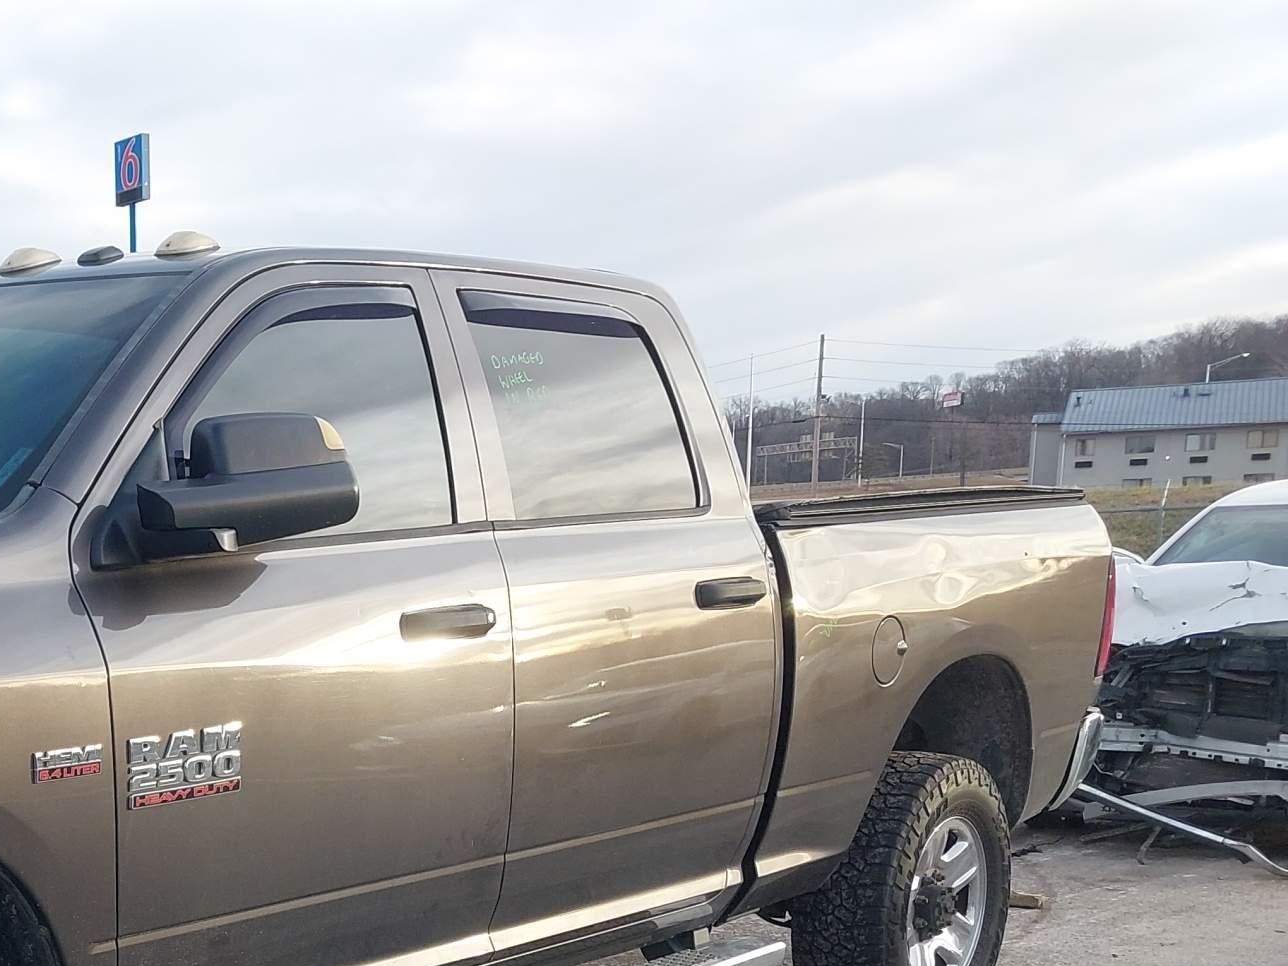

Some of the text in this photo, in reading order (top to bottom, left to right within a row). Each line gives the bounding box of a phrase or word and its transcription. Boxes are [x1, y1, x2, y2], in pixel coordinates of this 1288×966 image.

[120, 137, 140, 191] 6
[498, 370, 534, 389] WHEEL
[34, 744, 102, 768] HEMI
[127, 721, 243, 764] RAM
[63, 762, 100, 777] LITER
[129, 750, 241, 791] 2500
[135, 780, 238, 807] HEAVY DUTY
